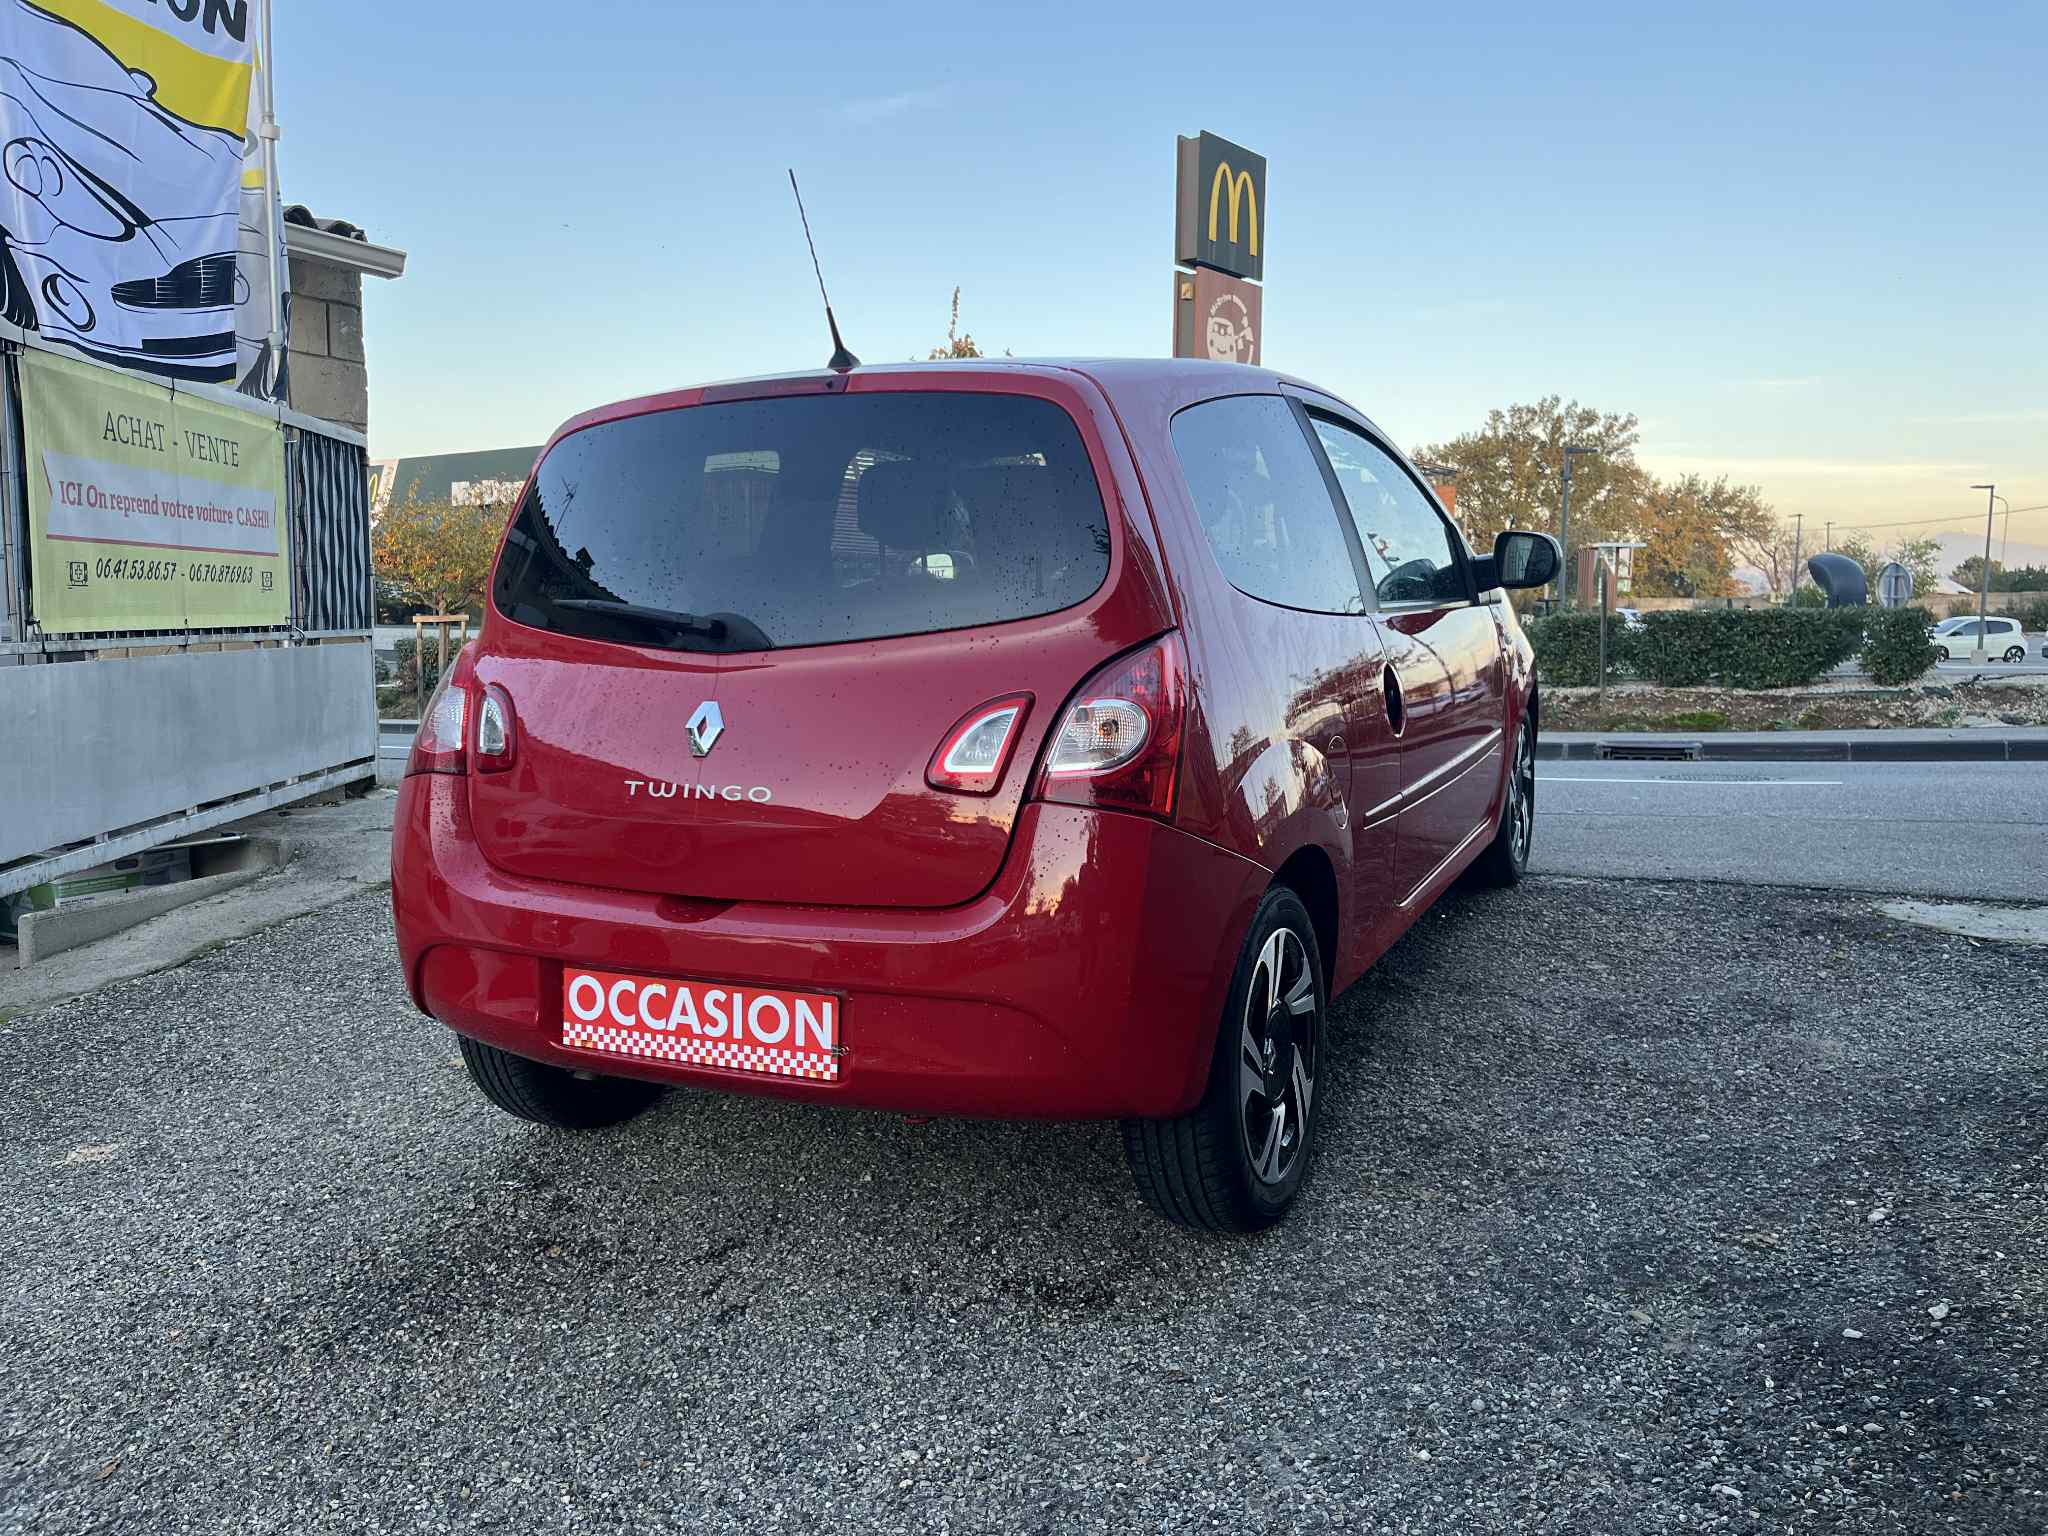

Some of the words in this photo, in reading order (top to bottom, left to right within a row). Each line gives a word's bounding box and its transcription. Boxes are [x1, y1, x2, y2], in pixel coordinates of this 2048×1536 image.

[102, 410, 165, 452] ACHAT
[184, 430, 239, 467] VENTE
[59, 480, 83, 506] ICI
[86, 484, 108, 509] On
[110, 494, 159, 517] reprend
[161, 499, 194, 520] votre
[196, 502, 233, 524] voiture
[624, 780, 772, 803] TWINGO
[568, 975, 832, 1050] OCCASION
